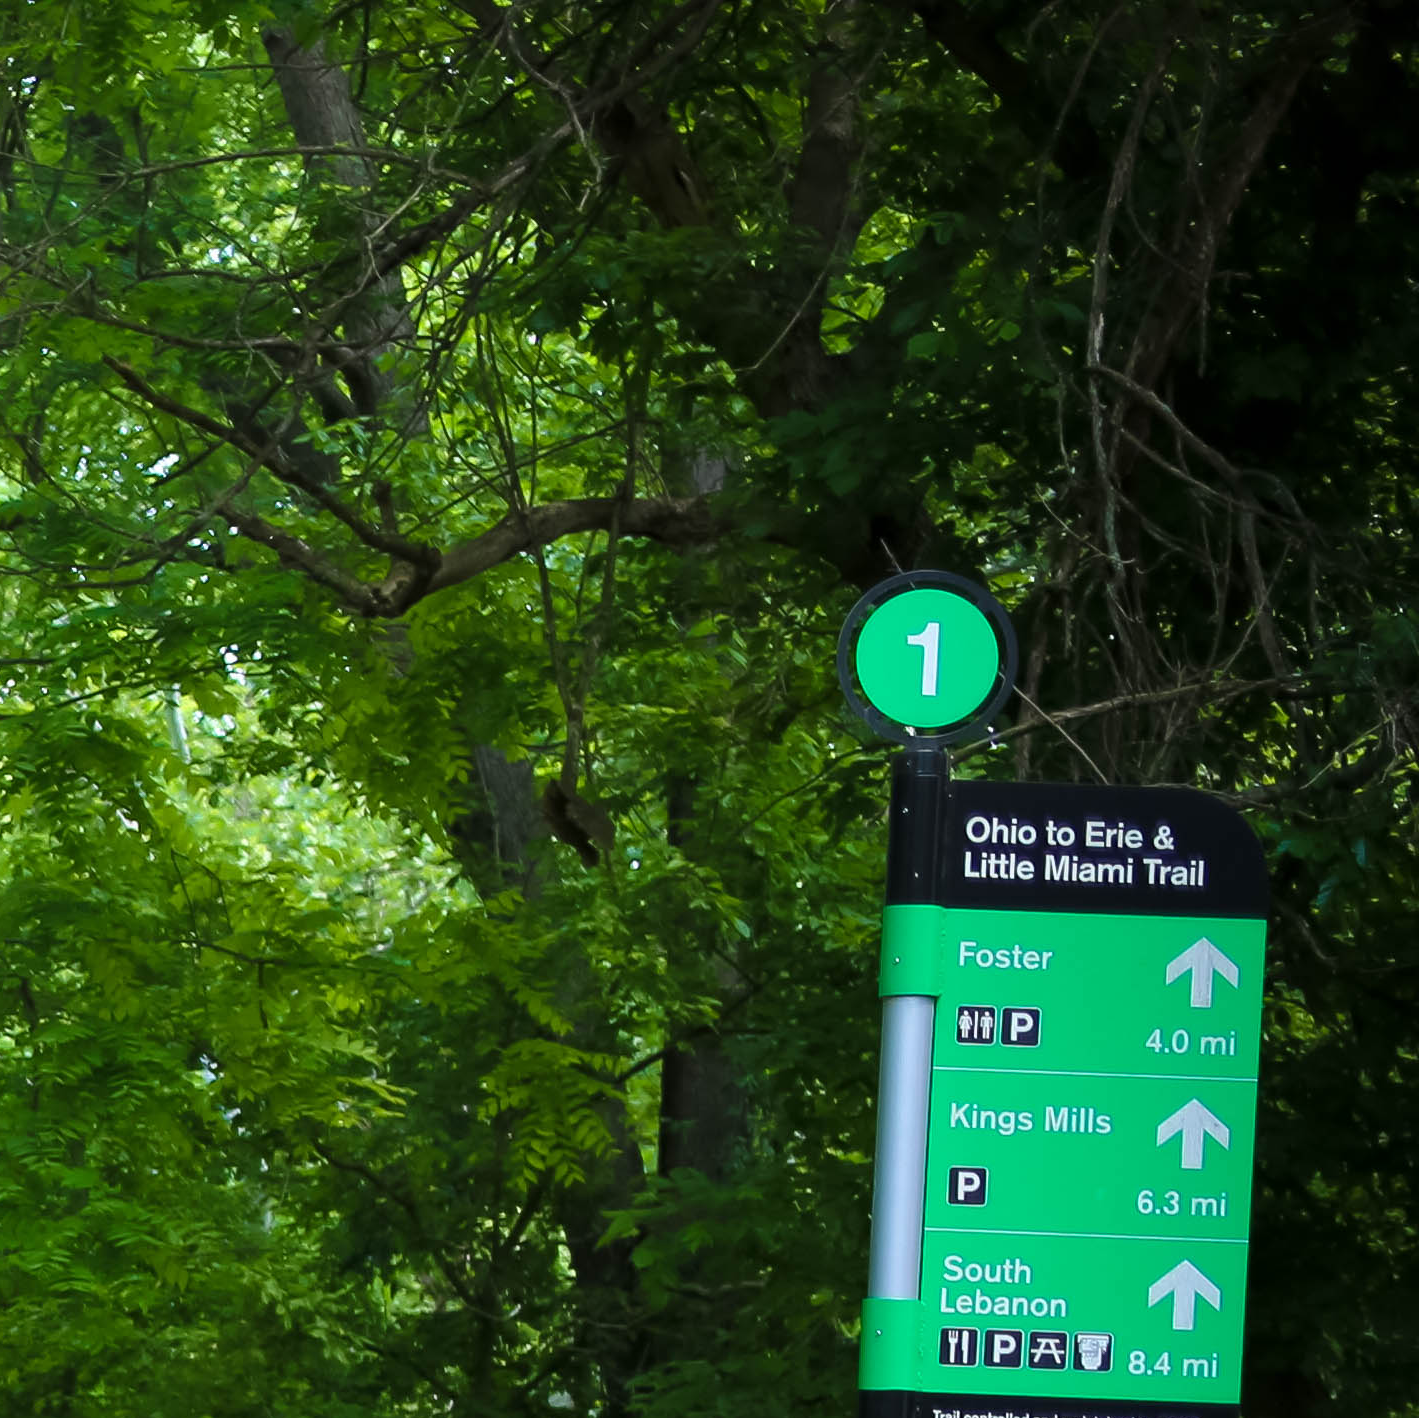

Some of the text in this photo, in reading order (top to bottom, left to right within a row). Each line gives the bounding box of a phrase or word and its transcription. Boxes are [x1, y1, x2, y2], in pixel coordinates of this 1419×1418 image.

[906, 622, 940, 697] 1
[965, 816, 1175, 851] Ohio to Erie &
[964, 851, 1205, 887] Little Miami Trail
[958, 940, 1053, 970] Foster
[1145, 1029, 1235, 1056] 4.0 mi
[950, 1102, 1112, 1136] Kings Mills
[1137, 1190, 1227, 1217] 6.3 mi
[943, 1255, 1032, 1285] South
[940, 1287, 1067, 1318] Lebanon
[1128, 1351, 1217, 1378] 8.4 mi
